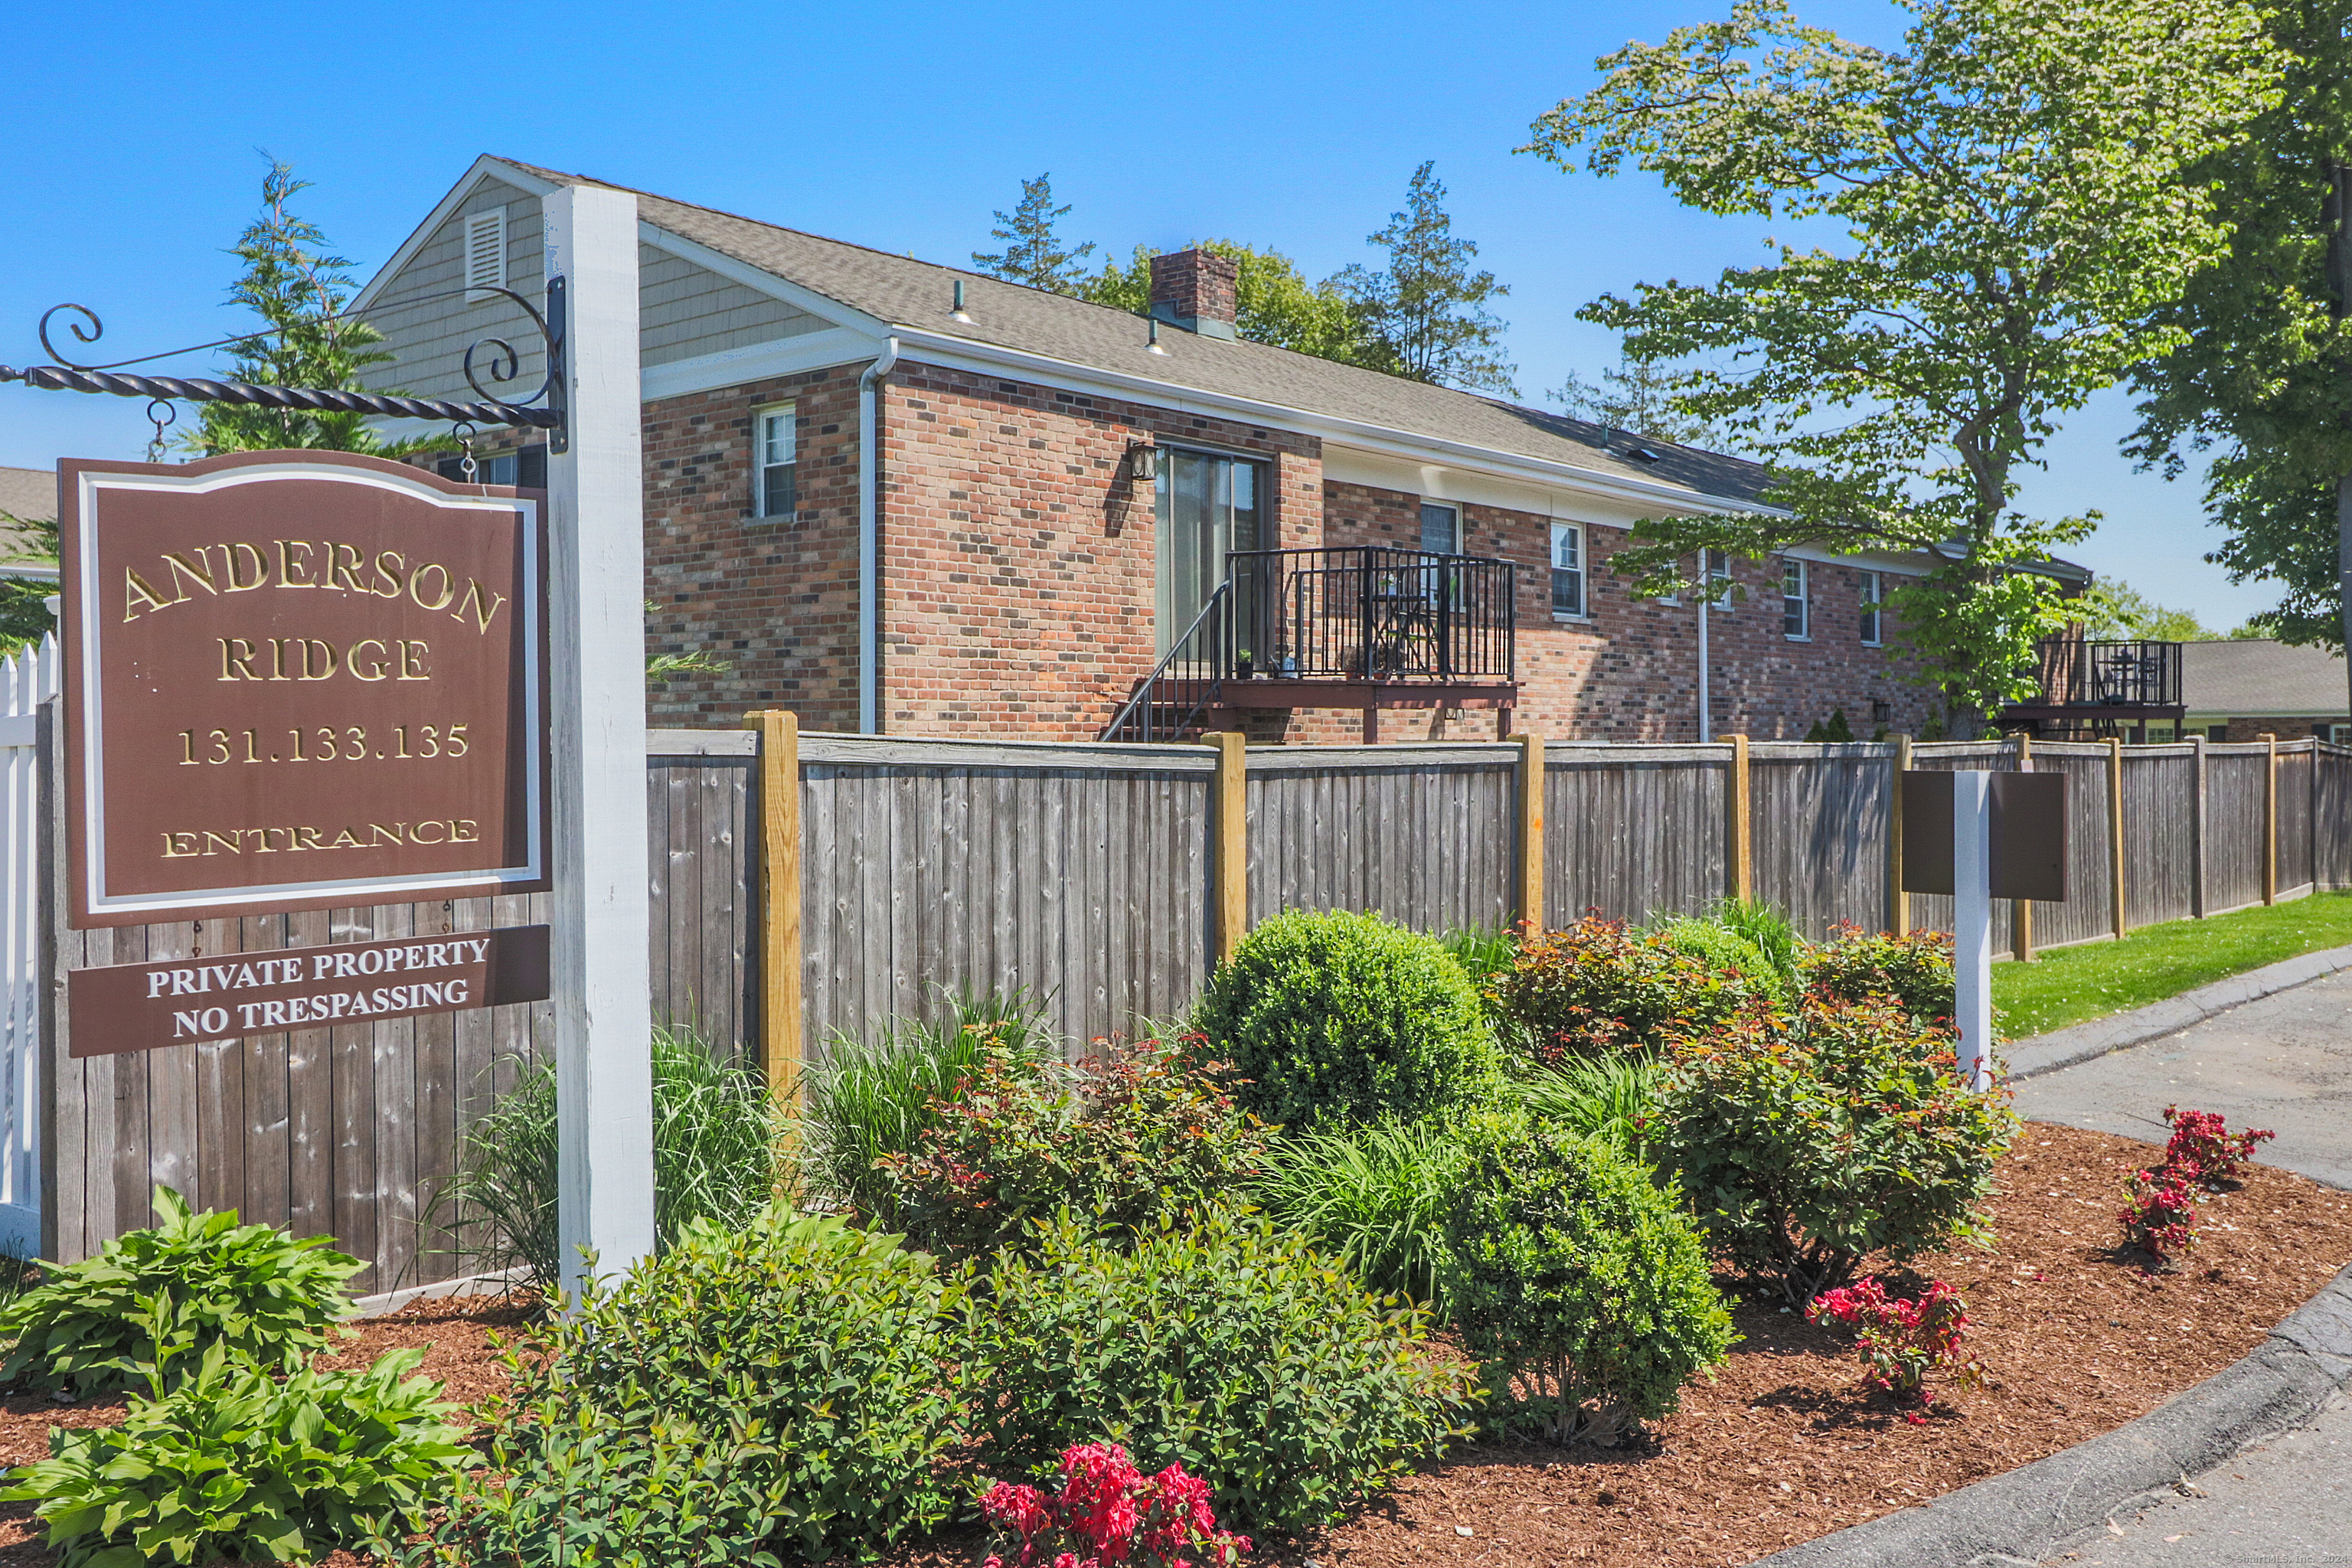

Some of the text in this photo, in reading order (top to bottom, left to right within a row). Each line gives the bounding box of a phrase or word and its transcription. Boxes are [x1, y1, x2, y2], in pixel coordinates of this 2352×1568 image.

[122, 540, 507, 635] ANDERSON
[216, 637, 431, 681] RIDGE
[178, 723, 470, 766] 131.133.135
[160, 819, 479, 858] ENTRANCE
[146, 938, 491, 998] PRIVATE PROPERTY
[172, 978, 469, 1038] NO TRESPASSING
